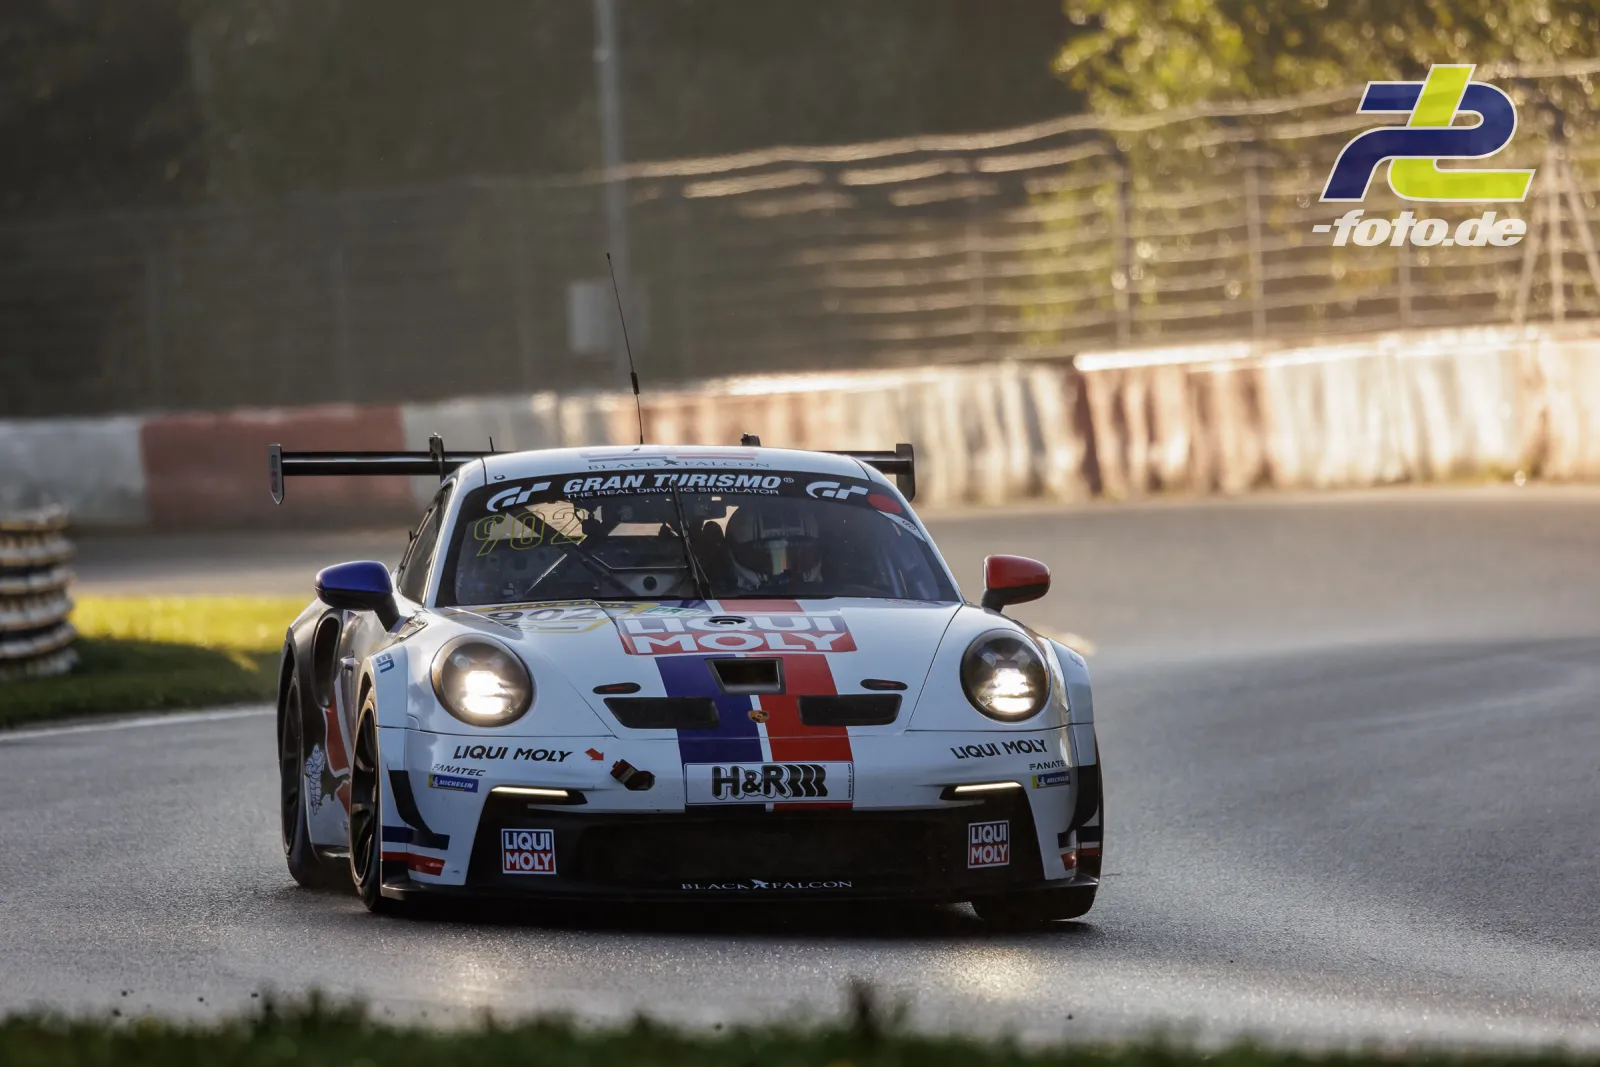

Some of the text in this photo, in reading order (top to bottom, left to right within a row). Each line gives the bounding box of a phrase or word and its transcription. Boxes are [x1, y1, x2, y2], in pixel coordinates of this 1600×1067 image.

[588, 460, 770, 471] BLACK FALCON
[563, 474, 645, 494] GRAN
[566, 491, 594, 499] THE
[698, 487, 780, 496] SIMULATOR
[474, 507, 588, 557] 902
[487, 607, 603, 622] 902
[622, 616, 838, 634] LIQUI
[631, 631, 847, 654] MOLY
[453, 745, 574, 762] LIQUI MOLY
[950, 739, 1048, 759] LIQUI MOLY
[432, 763, 487, 777] FANATEC
[1029, 759, 1068, 771] FANATE
[438, 779, 475, 789] MICHELIN
[505, 832, 551, 851] LIQUI
[971, 824, 1007, 843] LIQUI
[505, 852, 552, 870] MOLY
[971, 844, 1008, 864] MOLY
[772, 881, 852, 889] FALCON
